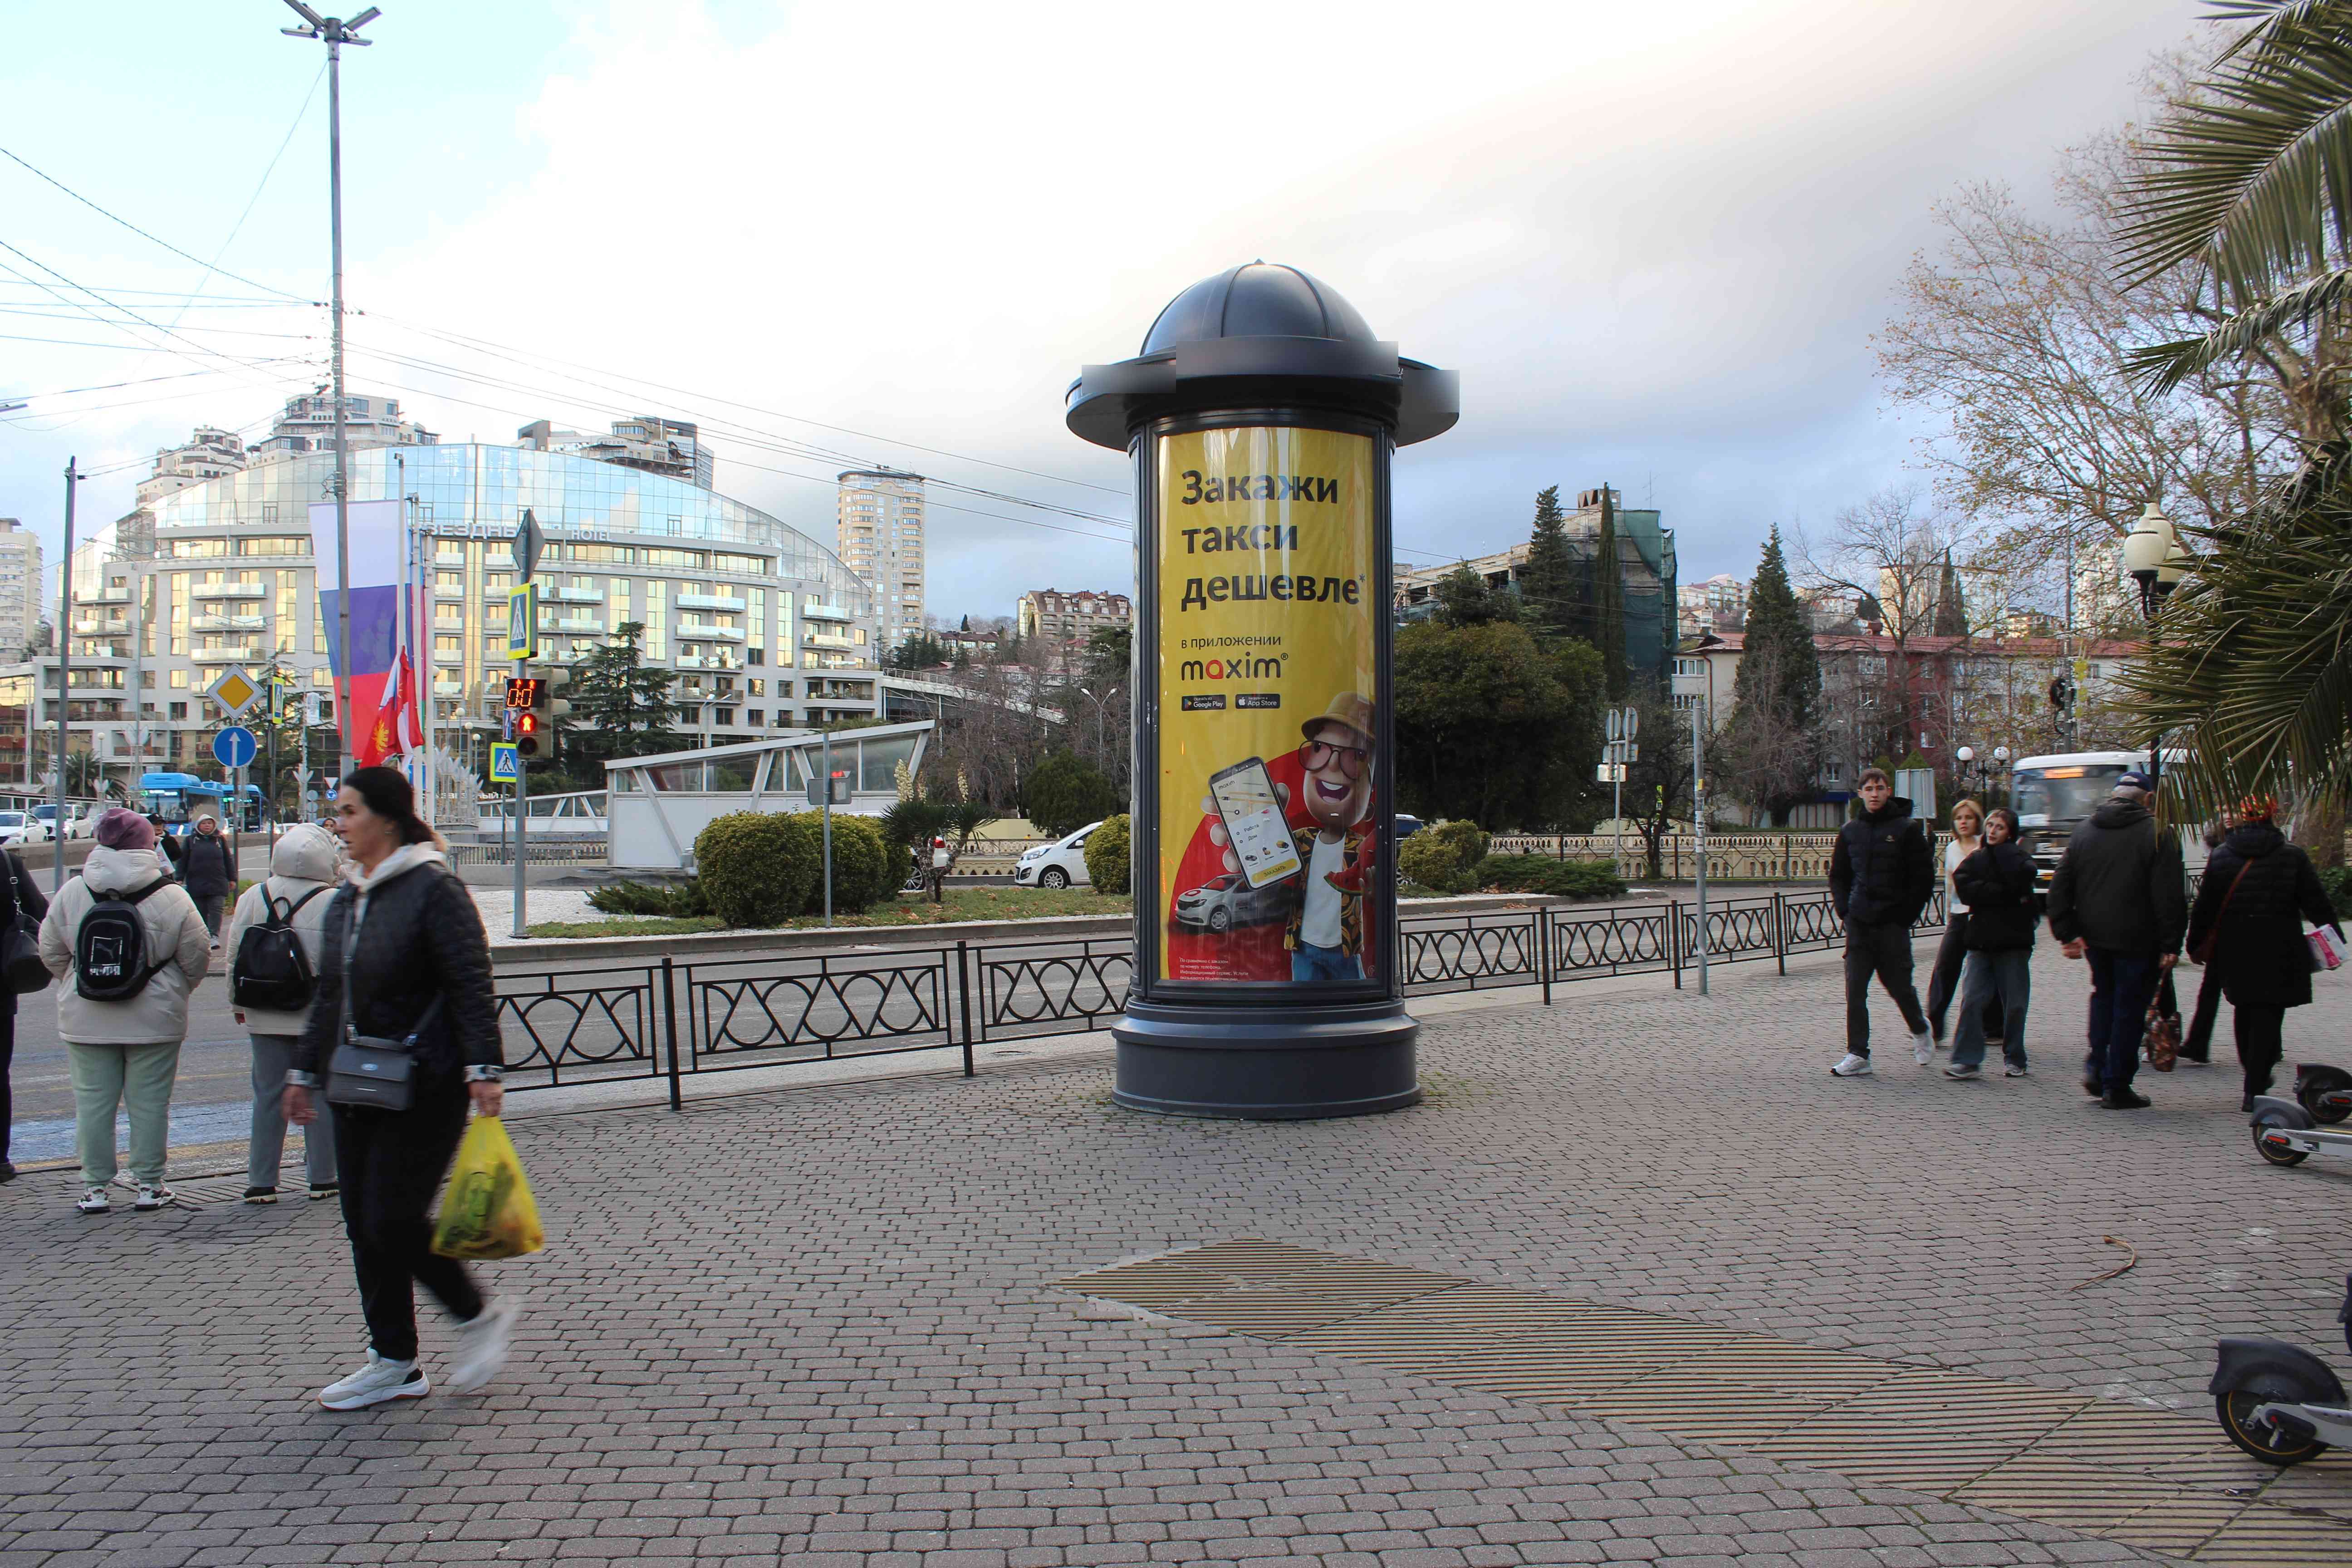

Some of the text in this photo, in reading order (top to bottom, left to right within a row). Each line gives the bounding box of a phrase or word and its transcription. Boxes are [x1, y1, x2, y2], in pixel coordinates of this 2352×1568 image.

[1181, 470, 1338, 504] Закажи
[572, 529, 612, 541] HOTEL
[1181, 524, 1298, 554] такси
[1181, 636, 1281, 650] в приложении
[1218, 780, 1235, 790] maxim
[1244, 823, 1259, 833] Работа
[1263, 865, 1286, 877] ЗАКАЗАТЬ
